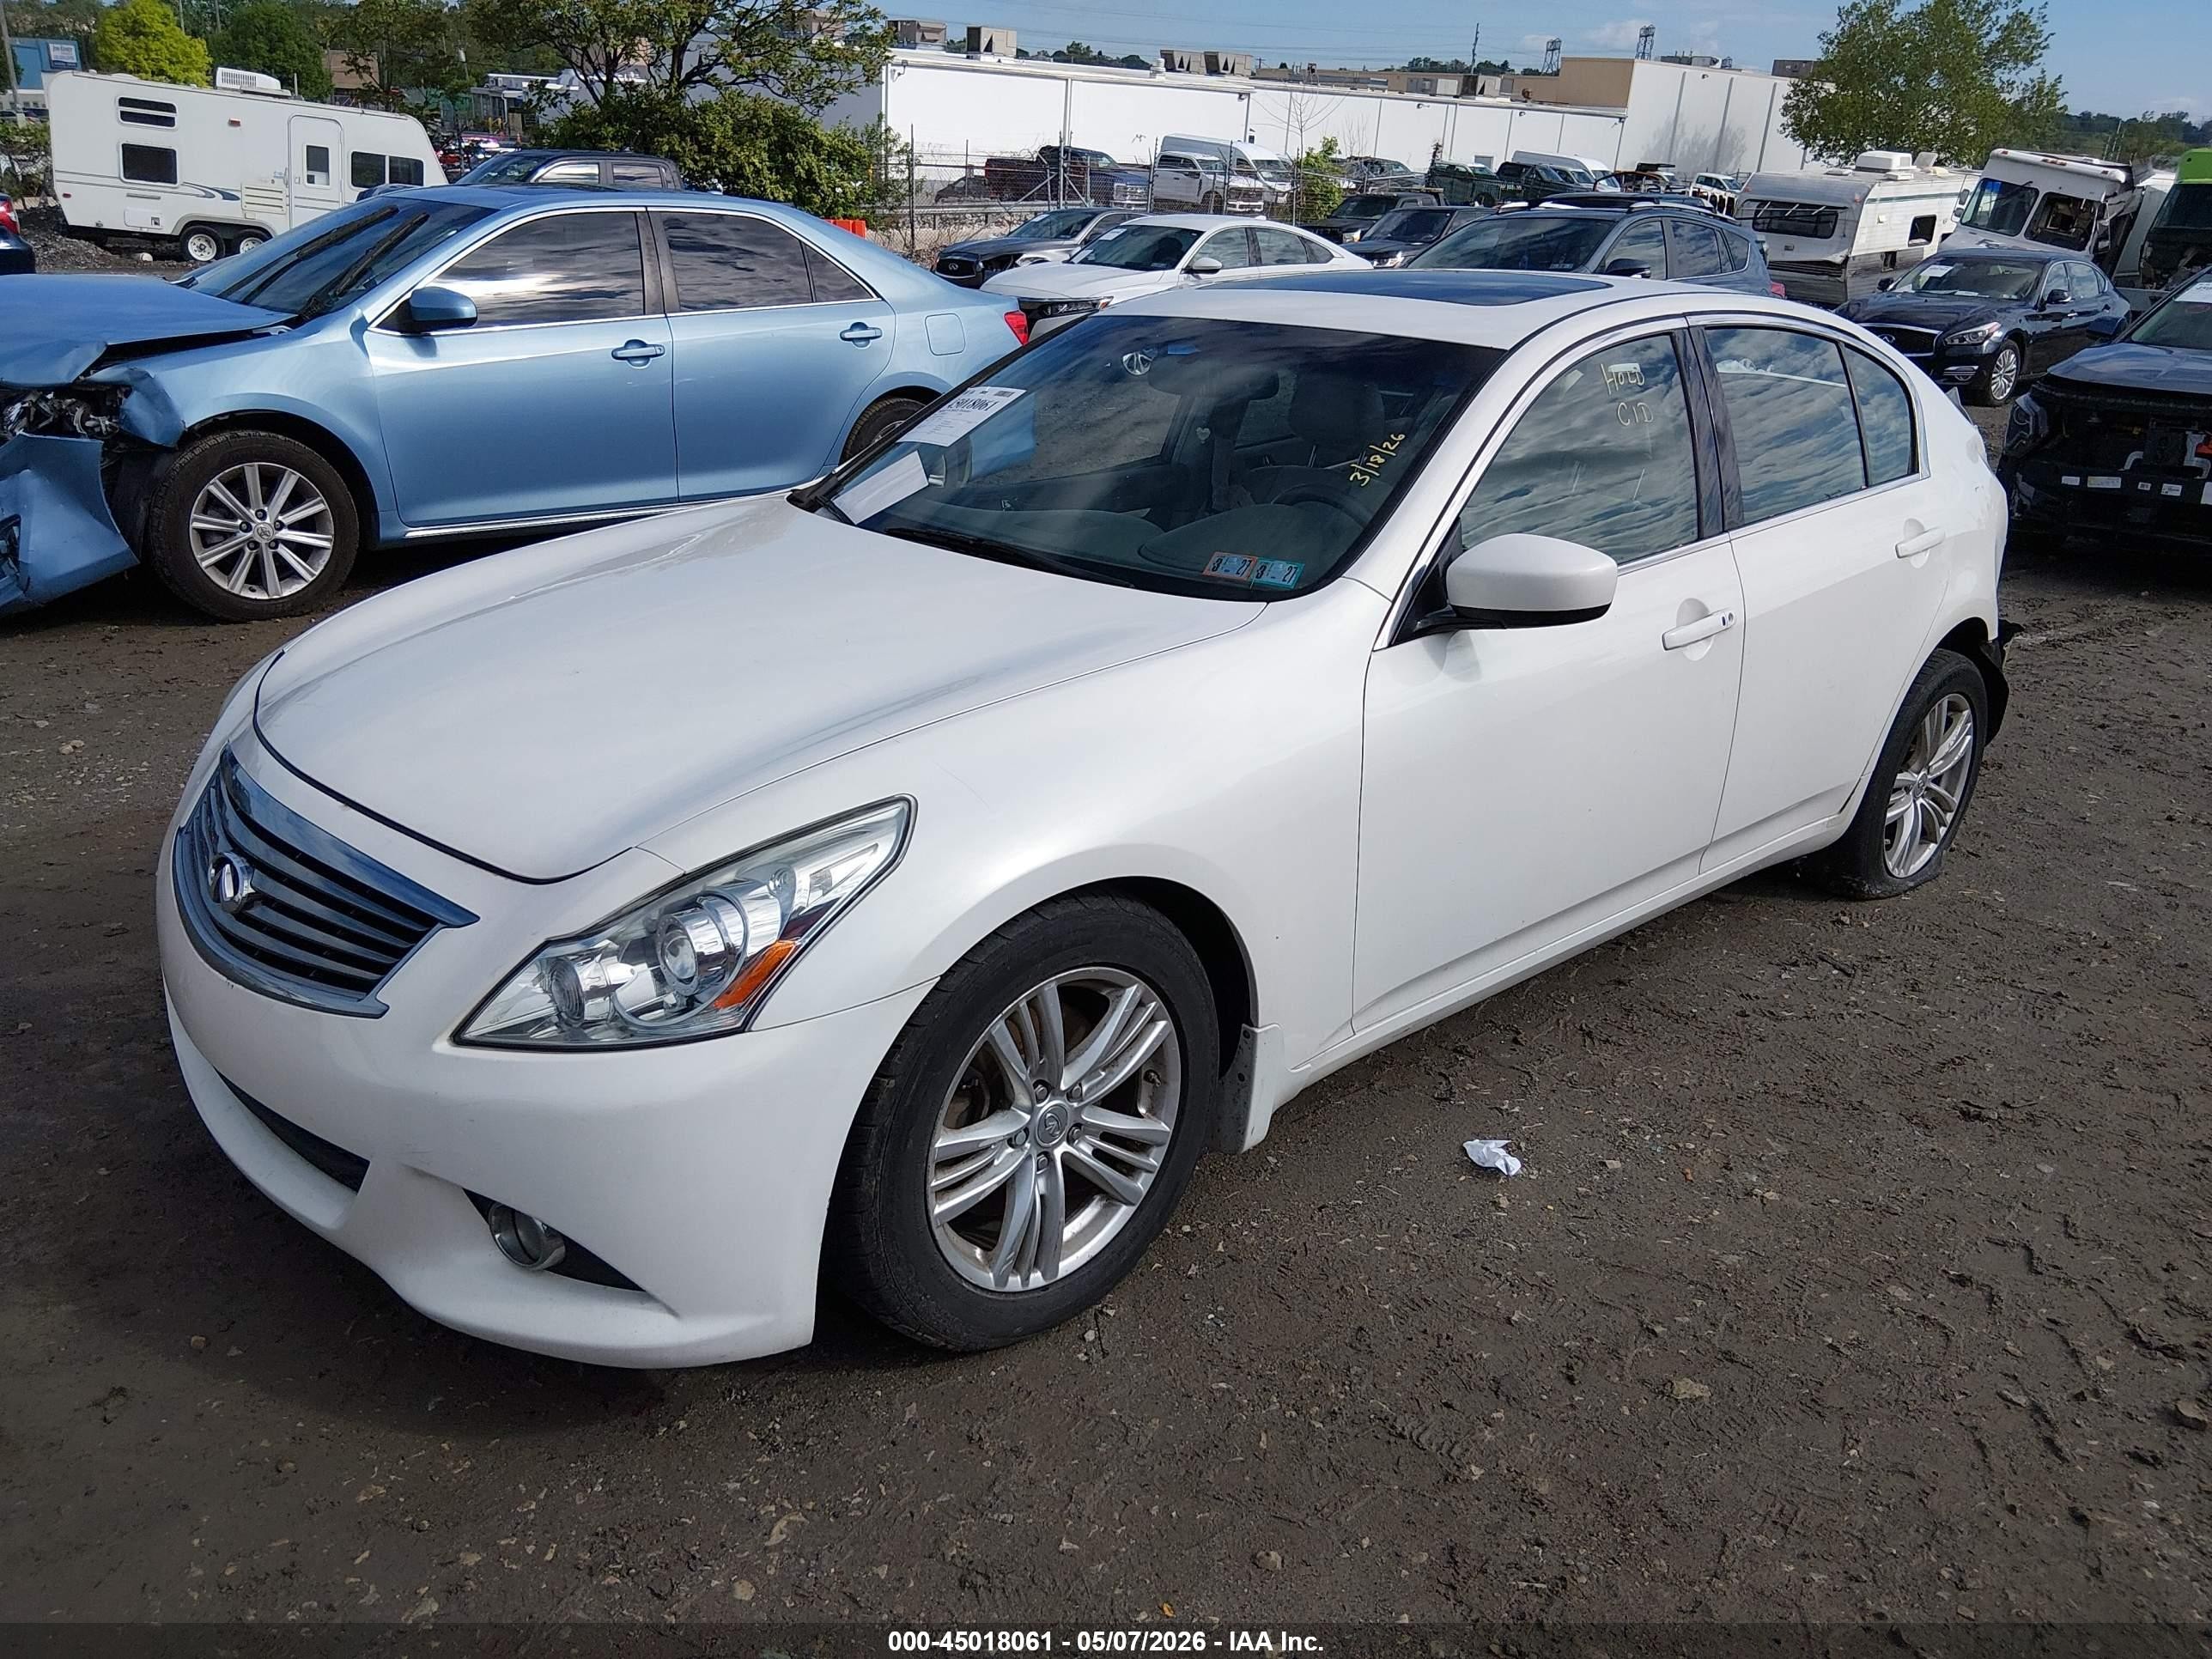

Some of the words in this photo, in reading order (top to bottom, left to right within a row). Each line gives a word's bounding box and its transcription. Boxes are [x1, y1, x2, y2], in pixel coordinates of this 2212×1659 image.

[1617, 402, 1654, 427] CID
[1349, 434, 1406, 487] 3/18/26
[1236, 559, 1253, 578] 27
[1282, 566, 1298, 585] 27
